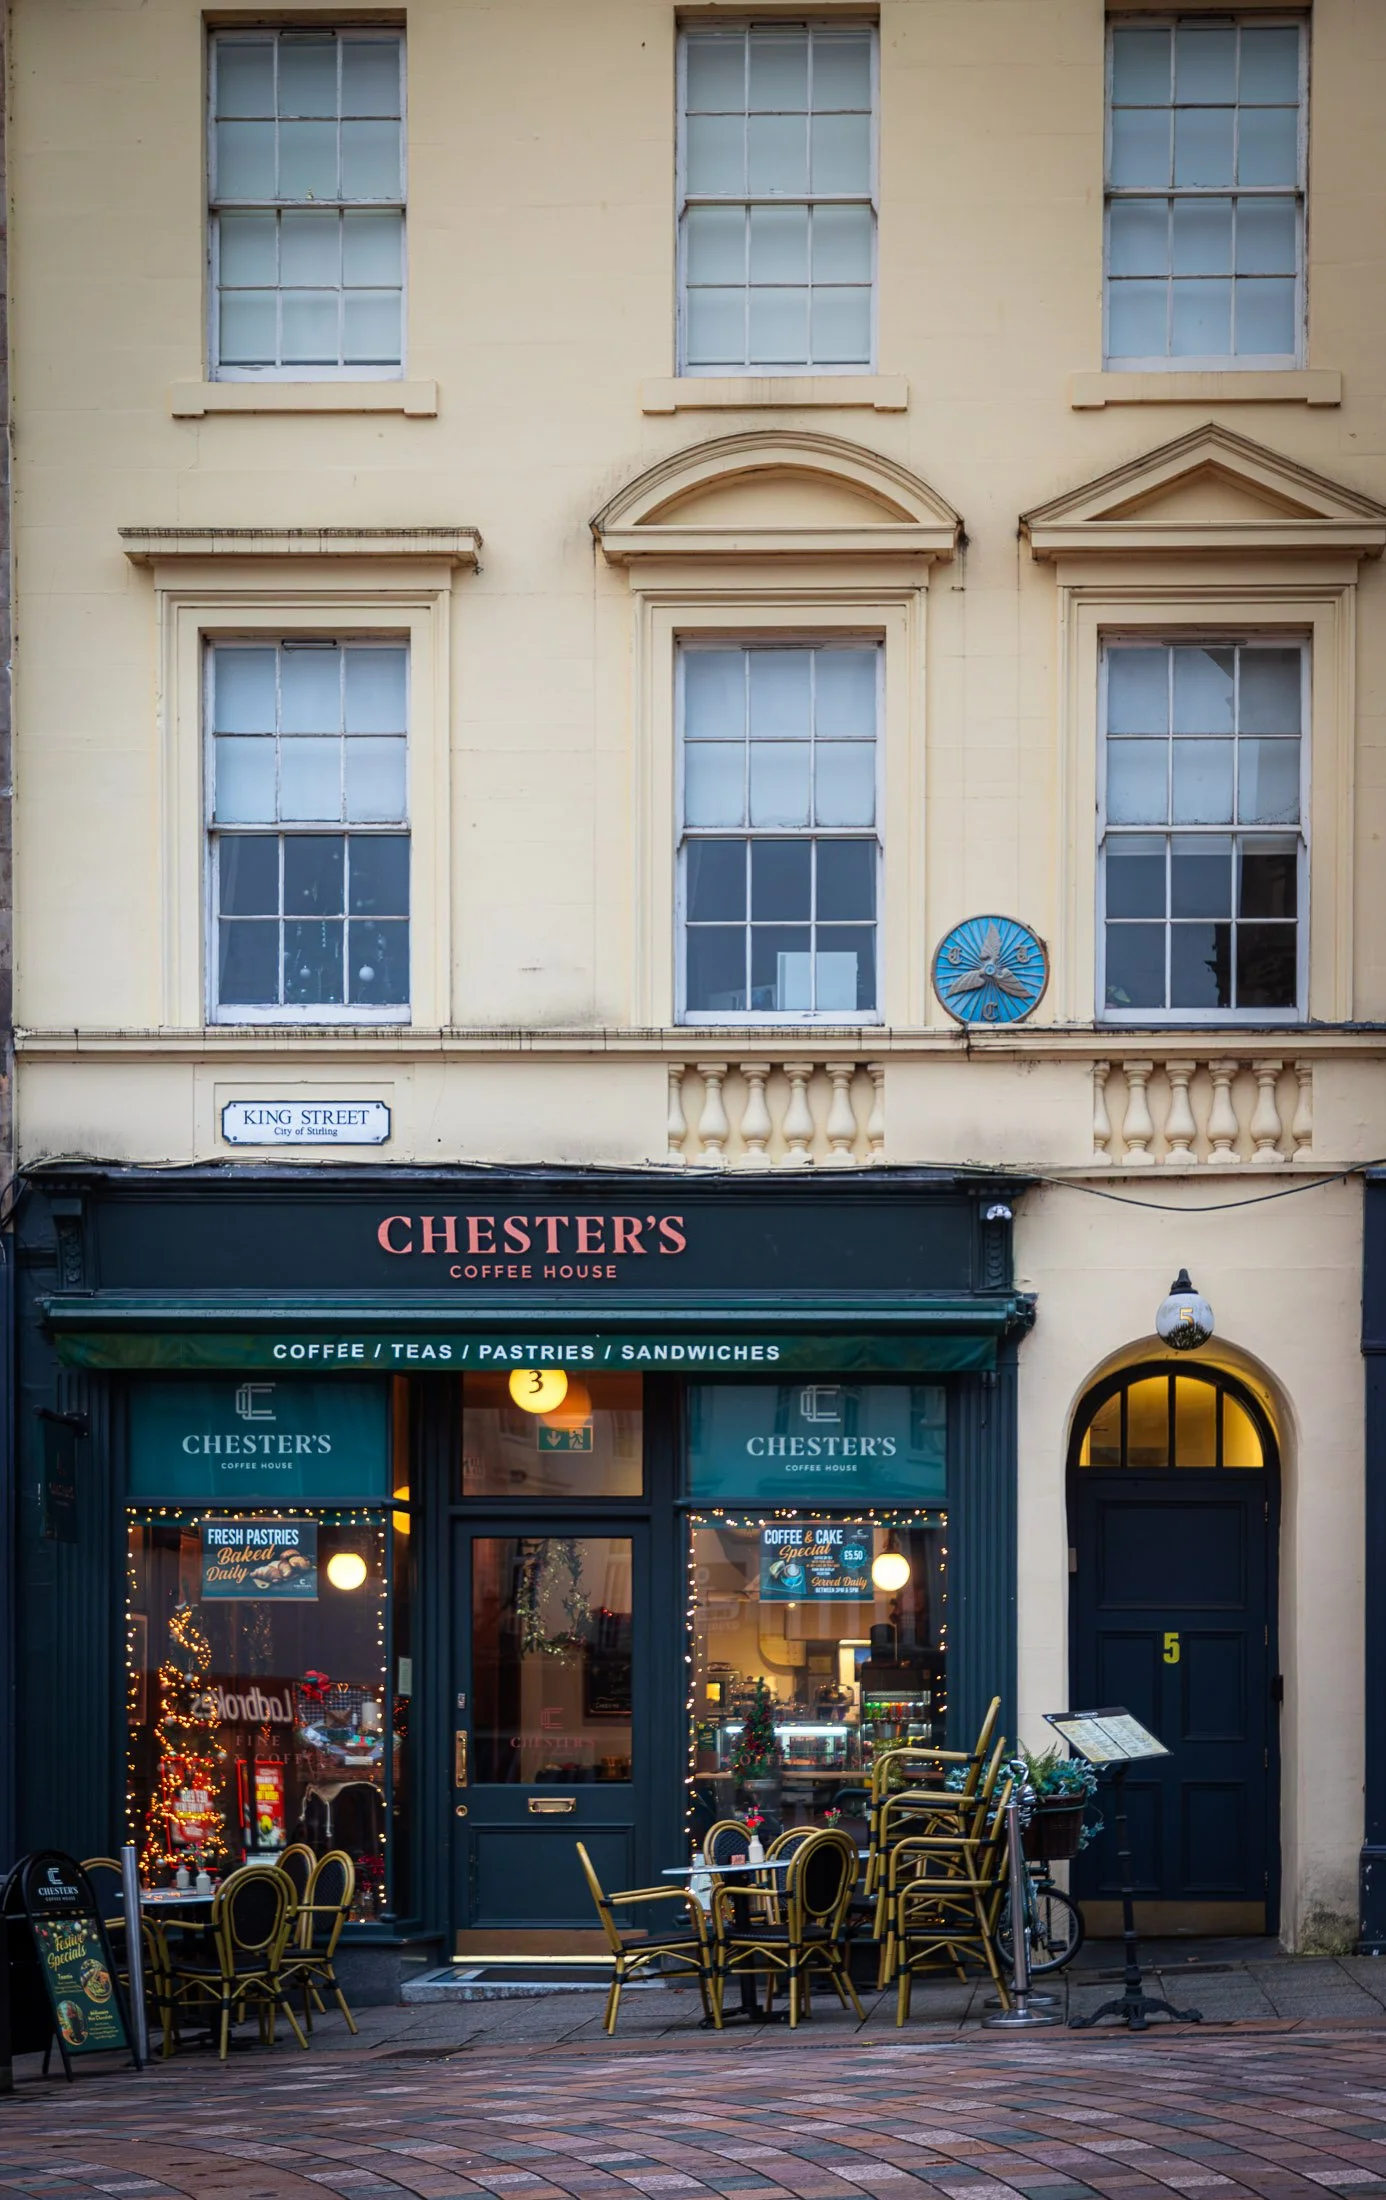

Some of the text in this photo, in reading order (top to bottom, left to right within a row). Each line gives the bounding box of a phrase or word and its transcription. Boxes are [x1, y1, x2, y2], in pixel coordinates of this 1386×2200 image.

[244, 1110, 370, 1125] KING STREET
[274, 1127, 338, 1136] City of Stirling
[377, 1215, 687, 1254] CHESTER'S
[450, 1265, 617, 1279] COFFEE HOUSE
[1179, 1307, 1195, 1331] 5
[273, 1344, 364, 1359] COFFEE
[391, 1344, 452, 1359] TEAS
[479, 1345, 594, 1359] PASTRIES
[621, 1345, 780, 1360] SANDWICHES
[529, 1370, 543, 1394] 3
[182, 1434, 332, 1454] CHESTER'S
[747, 1436, 897, 1456] CHESTER'S
[221, 1462, 293, 1470] COFFEE HOUSE
[785, 1464, 858, 1472] COFFEE HOUSE
[208, 1528, 299, 1545] FRESH PASTRIES
[764, 1529, 844, 1545] COFFEE & CAKE
[217, 1544, 275, 1565] Baked
[779, 1543, 831, 1562] Special
[843, 1550, 864, 1560] £5.50
[206, 1565, 248, 1583] Daily
[811, 1577, 868, 1590] Served Daily
[1163, 1632, 1180, 1664] 5
[55, 1933, 85, 1952] Festive
[47, 1944, 86, 1971] Specials
